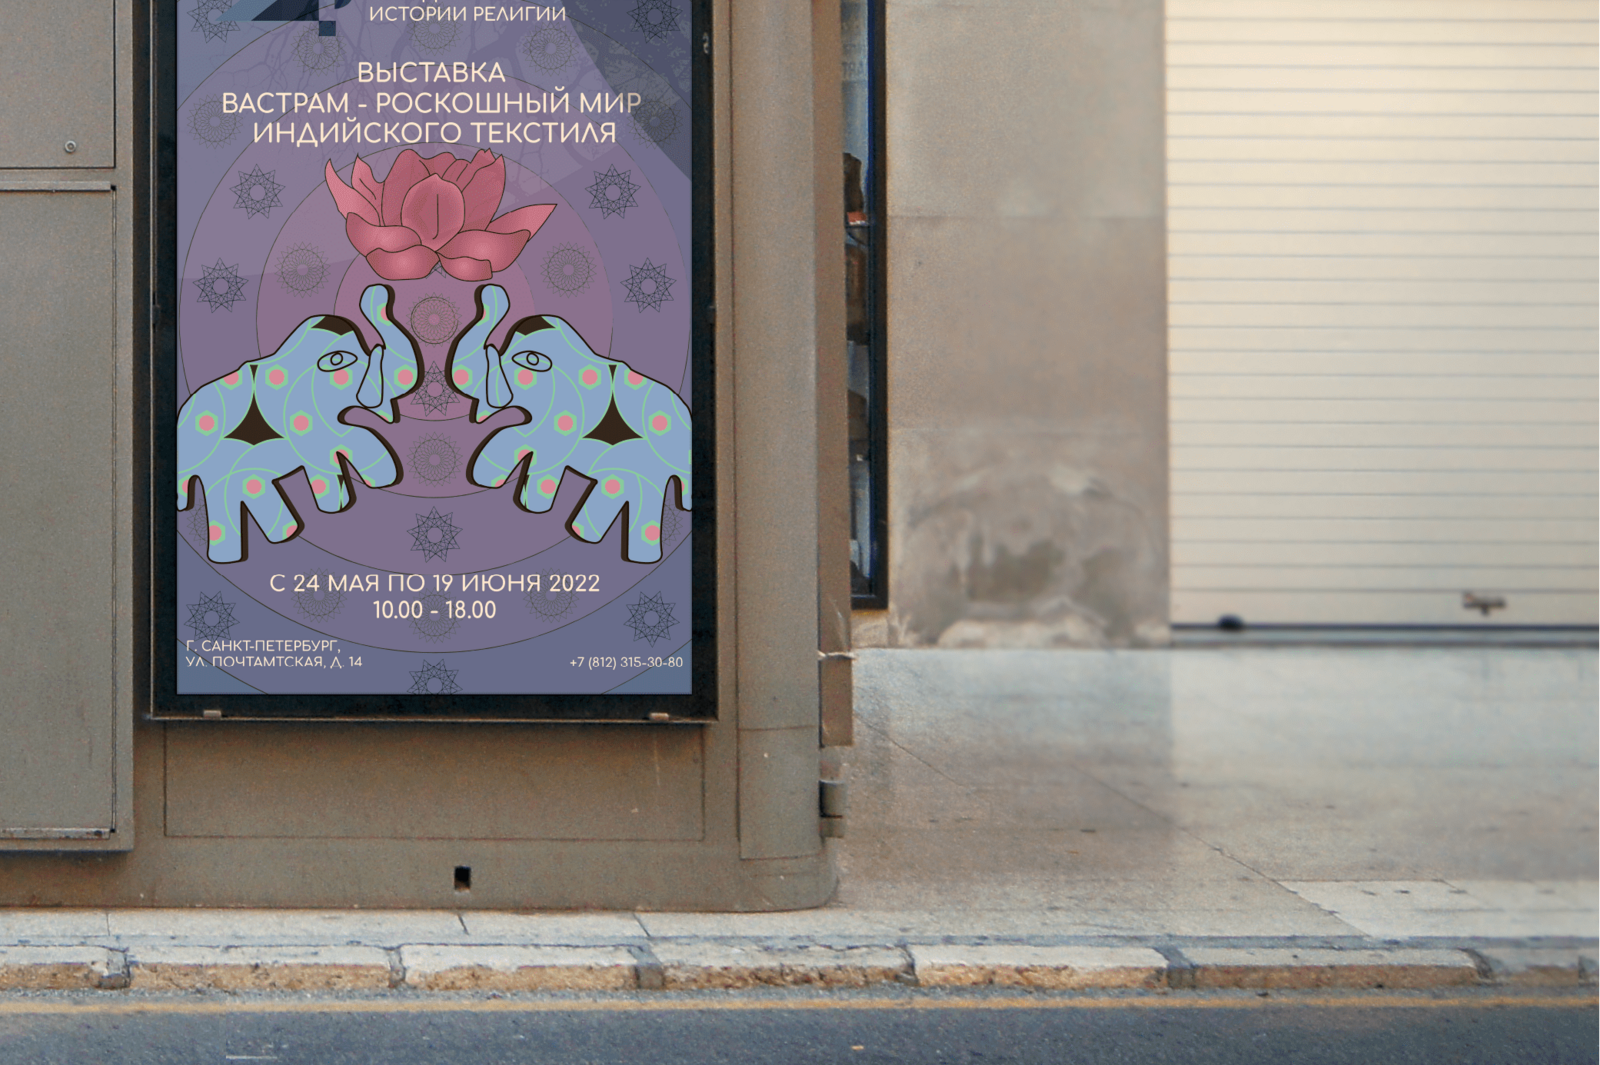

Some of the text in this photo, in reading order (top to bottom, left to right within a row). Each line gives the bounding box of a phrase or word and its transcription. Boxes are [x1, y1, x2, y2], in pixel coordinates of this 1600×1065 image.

[369, 5, 566, 22] ИСТОРИИ РЕЛИГИИ
[358, 61, 506, 83] ВЫСТАВКА
[222, 91, 349, 114] ВАСТРАМ
[376, 85, 570, 114] РОСКОШНЫЙ
[580, 92, 641, 114] МИР
[253, 116, 616, 148] ИНДИЙСКОГО ТЕКСТИЛЯ
[269, 573, 600, 593] С 24 МАЯ ПО 19 ИЮНЯ 2022
[373, 599, 423, 619] 10.00
[445, 599, 497, 619] 18.00
[186, 639, 341, 654] Г. САНКТ-ПЕТЕРБУРГ,
[212, 655, 327, 669] ПОЧТАМТСКАЯ,
[348, 655, 363, 667] 14
[569, 656, 684, 671] +7 (812) 315-30-80
